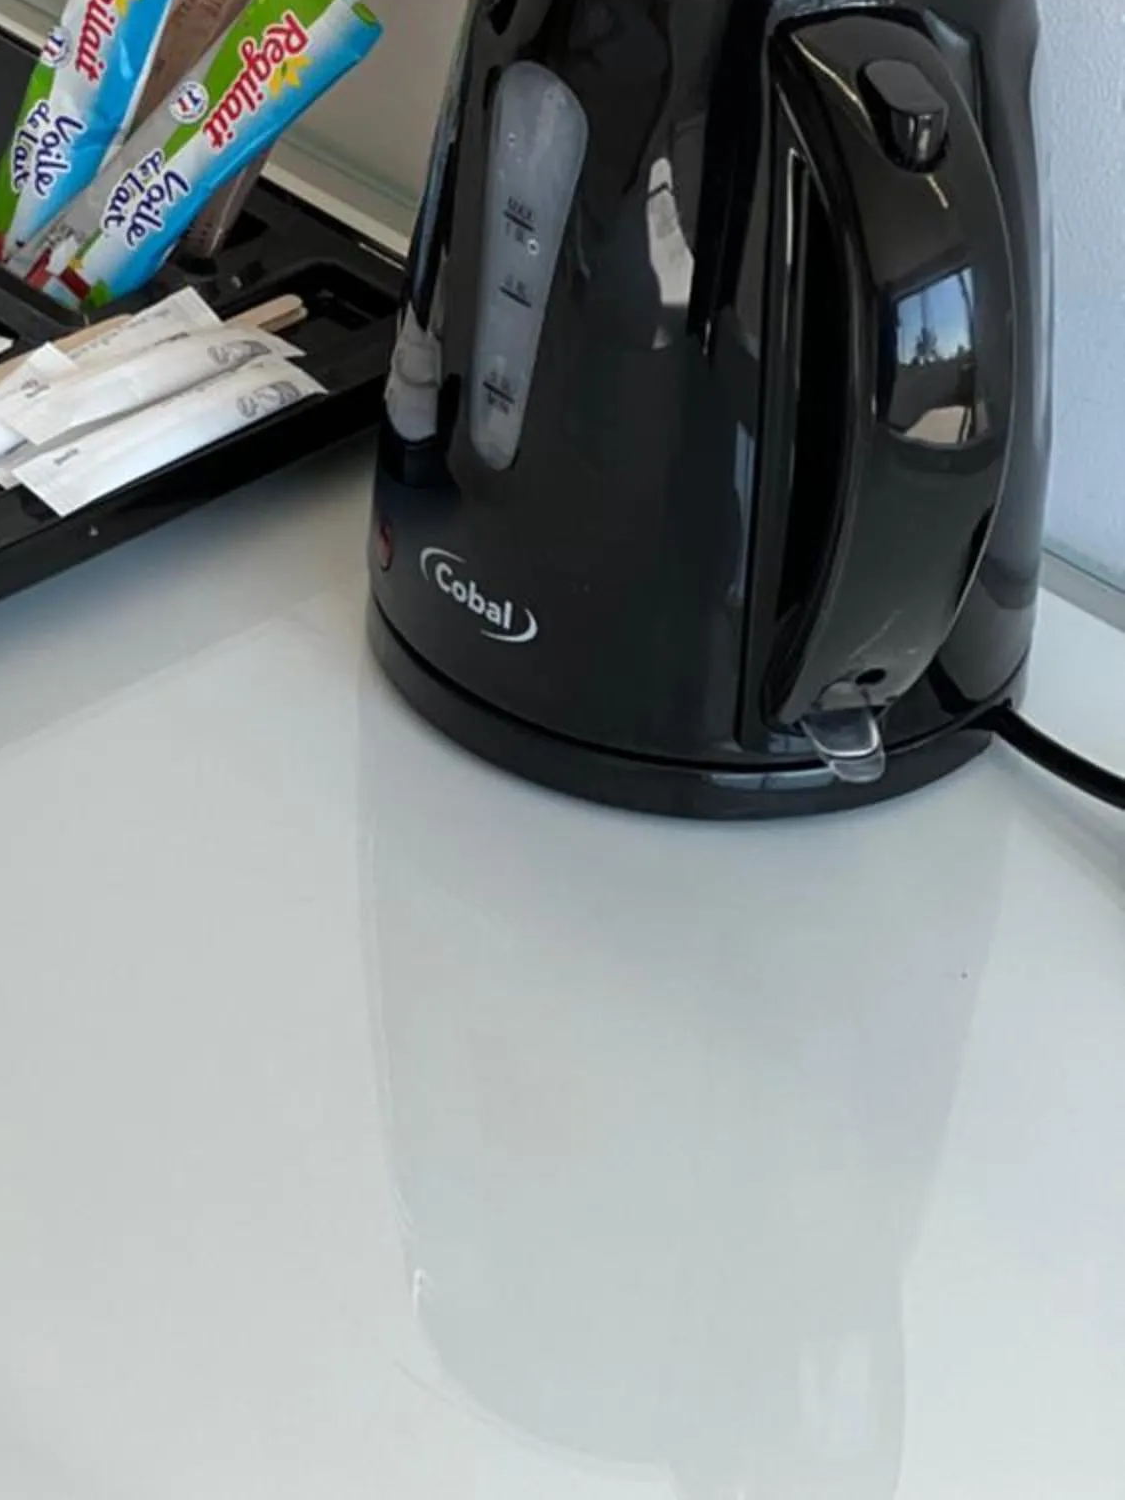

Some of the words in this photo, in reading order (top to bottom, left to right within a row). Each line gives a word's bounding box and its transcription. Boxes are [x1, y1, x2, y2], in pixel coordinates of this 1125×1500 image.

[27, 102, 50, 128] de
[202, 13, 308, 148] Regilait
[35, 115, 83, 195] Voile
[139, 151, 162, 176] de
[126, 170, 189, 246] Voile
[435, 561, 513, 630] Cobal
